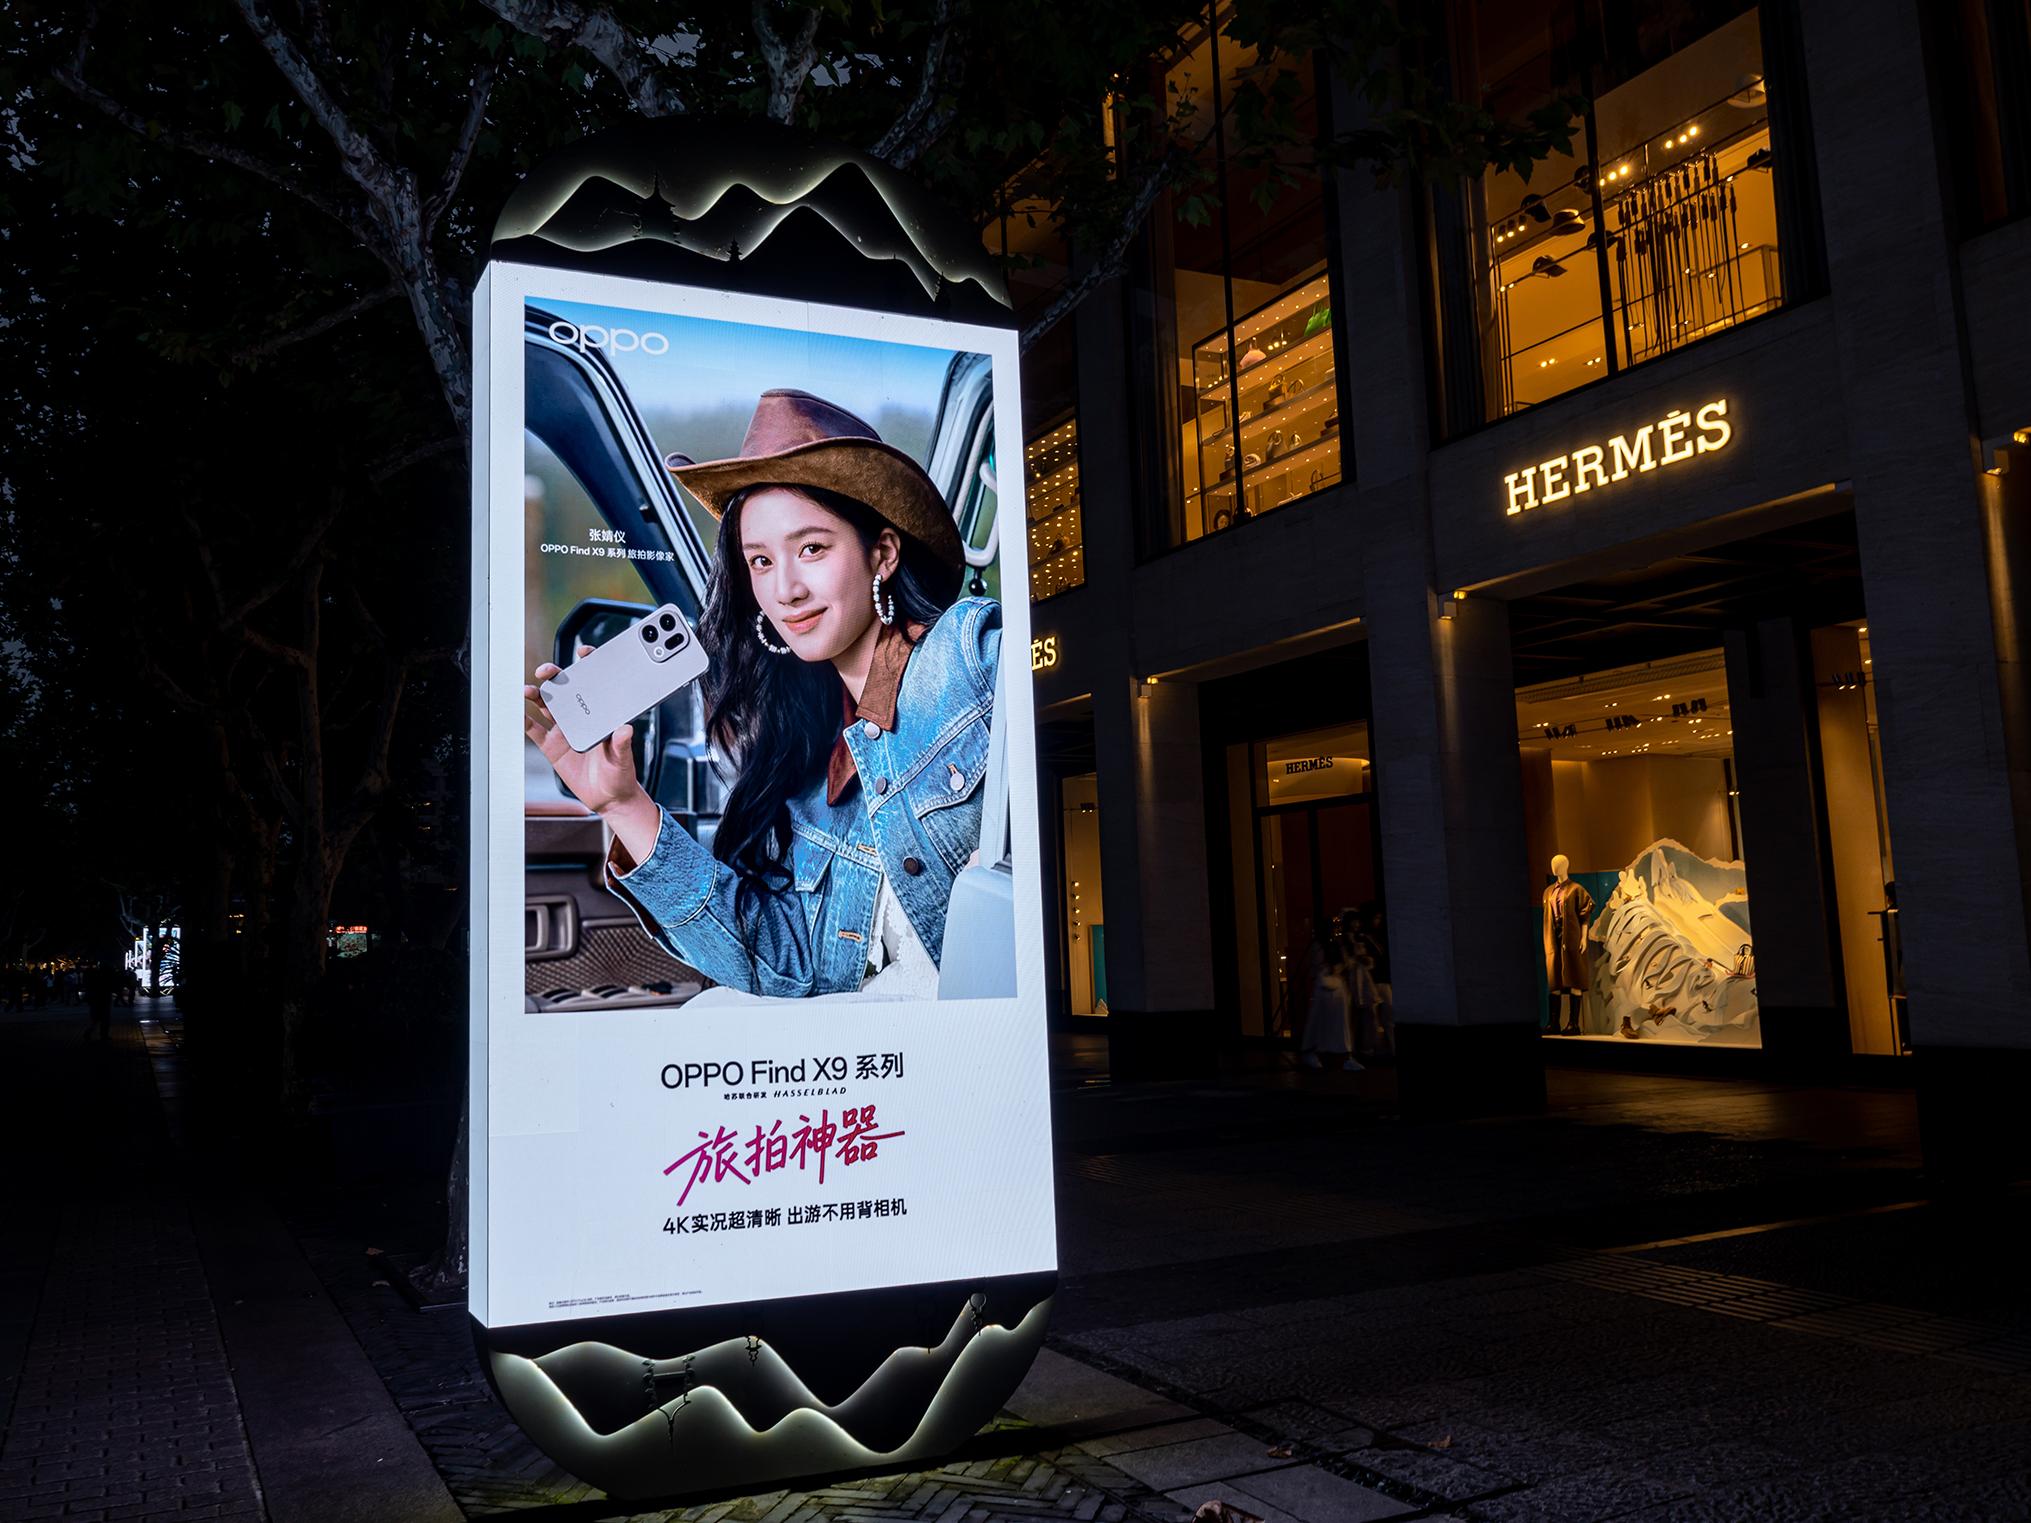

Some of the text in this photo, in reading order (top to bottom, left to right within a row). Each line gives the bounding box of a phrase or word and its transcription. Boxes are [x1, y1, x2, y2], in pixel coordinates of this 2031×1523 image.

[540, 543, 569, 554] OPPO
[570, 545, 590, 556] Find
[592, 546, 605, 557] X9
[606, 547, 626, 559] 系列
[660, 1052, 904, 1089] OPPO Find X9 系列
[773, 1087, 847, 1098] HASSELBLAD
[663, 1104, 905, 1207] 旅拍神器
[663, 1198, 908, 1235] 4K实况超清晰 出游不用背相机
